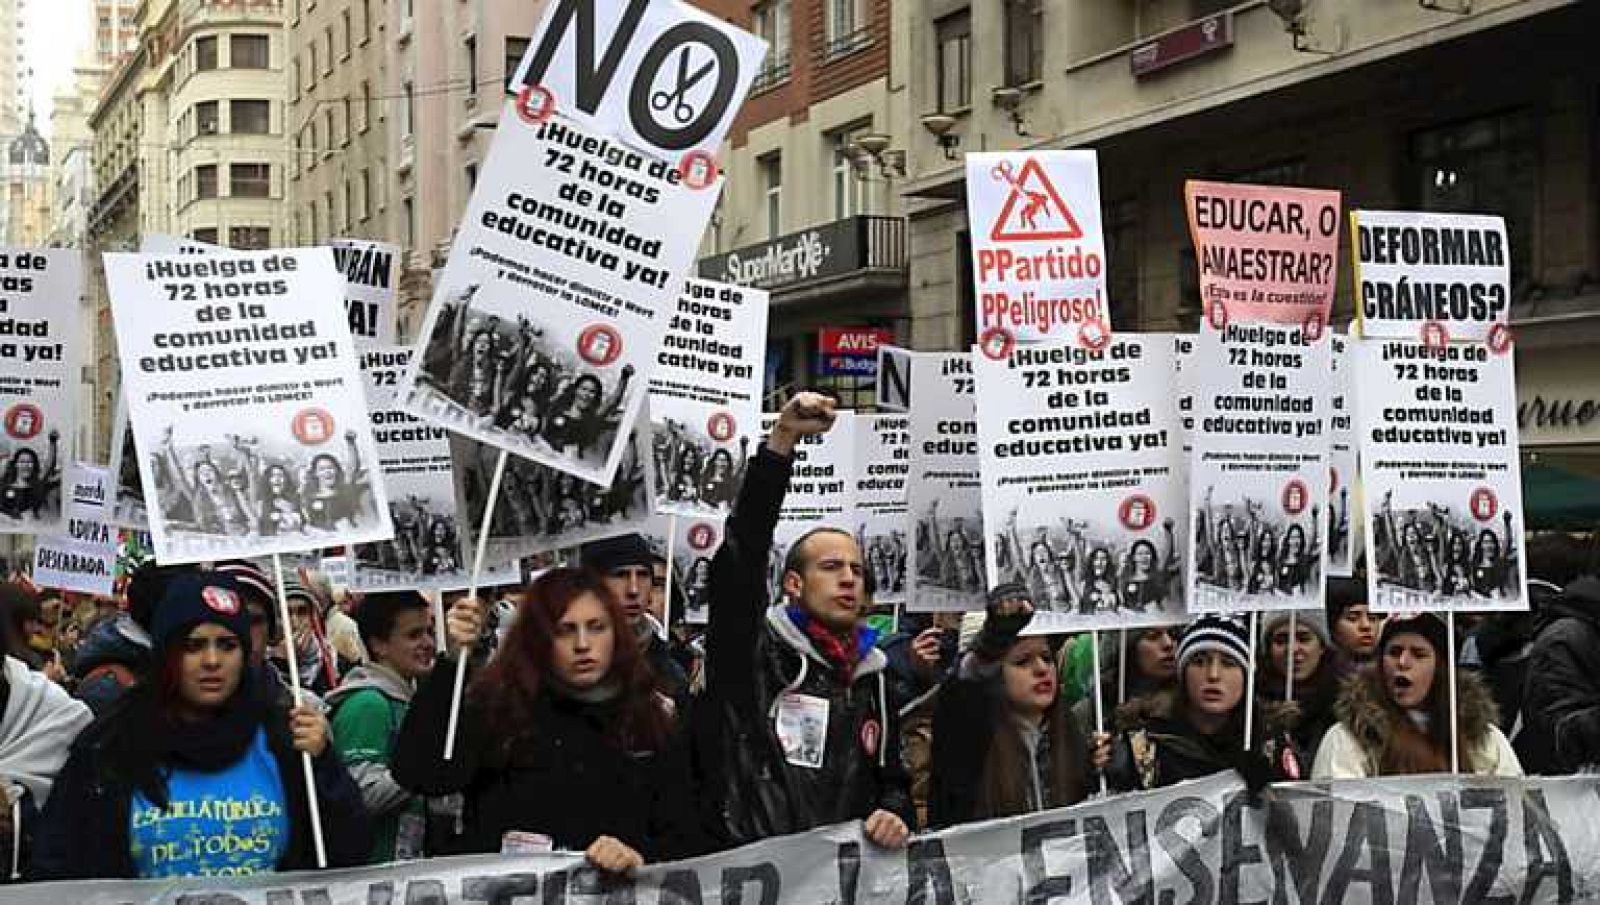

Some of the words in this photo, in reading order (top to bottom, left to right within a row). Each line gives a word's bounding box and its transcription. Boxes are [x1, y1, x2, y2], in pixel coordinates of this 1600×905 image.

[523, 0, 739, 150] NO
[536, 123, 642, 170] ¡Huelga
[648, 160, 683, 186] de
[544, 148, 576, 174] 72
[579, 160, 661, 204] horas
[559, 182, 592, 206] de
[597, 194, 625, 219] la
[507, 192, 662, 259] comunidad
[1195, 195, 1311, 241] EDUCAR,
[1319, 205, 1336, 237] O
[482, 210, 619, 270] educativa
[623, 260, 670, 289] ya!
[1358, 225, 1504, 265] DEFORMAR
[146, 259, 256, 280] ¡Huelga
[262, 254, 298, 271] de
[977, 246, 1100, 282] PPartido
[1202, 243, 1332, 284] AMAESTRAR?
[164, 283, 198, 300] 72
[204, 279, 288, 299] horas
[719, 288, 743, 304] de
[1362, 275, 1505, 321] CRÁNEOS?
[196, 304, 232, 323] de
[237, 302, 266, 319] la
[344, 299, 378, 337] A!
[677, 298, 732, 321] horas
[982, 287, 1102, 333] PPeligroso!
[153, 320, 317, 349] comunidad
[695, 319, 714, 335] la
[1221, 325, 1286, 347] ¡Huelga
[837, 333, 878, 349] AVIS
[24, 343, 63, 362] ya!
[139, 347, 288, 372] educativa
[294, 341, 338, 365] ya!
[1008, 345, 1105, 369] ¡Huelga
[1111, 341, 1142, 359] de
[1229, 348, 1247, 366] 72
[1251, 350, 1303, 368] horas
[1382, 343, 1459, 362] ¡Huelga
[1463, 345, 1488, 362] de
[372, 371, 397, 386] 72
[723, 363, 752, 380] ya!
[1023, 370, 1051, 388] 72
[1057, 367, 1131, 386] horas
[1242, 371, 1266, 388] de
[1270, 372, 1287, 389] la
[1394, 364, 1419, 380] 72
[1424, 364, 1478, 383] horas
[1047, 391, 1078, 409] de
[1085, 389, 1109, 406] la
[1214, 394, 1313, 412] comunidad
[1415, 385, 1442, 402] de
[1445, 385, 1463, 402] la
[1008, 408, 1151, 434] comunidad
[1383, 406, 1494, 424] comunidad
[1203, 416, 1293, 434] educativa
[1295, 418, 1322, 438] ya!
[1371, 427, 1473, 445] educativa
[1476, 429, 1507, 447] ya!
[993, 434, 1123, 458] educativa
[1128, 429, 1167, 451] ya!
[818, 480, 845, 495] ya!
